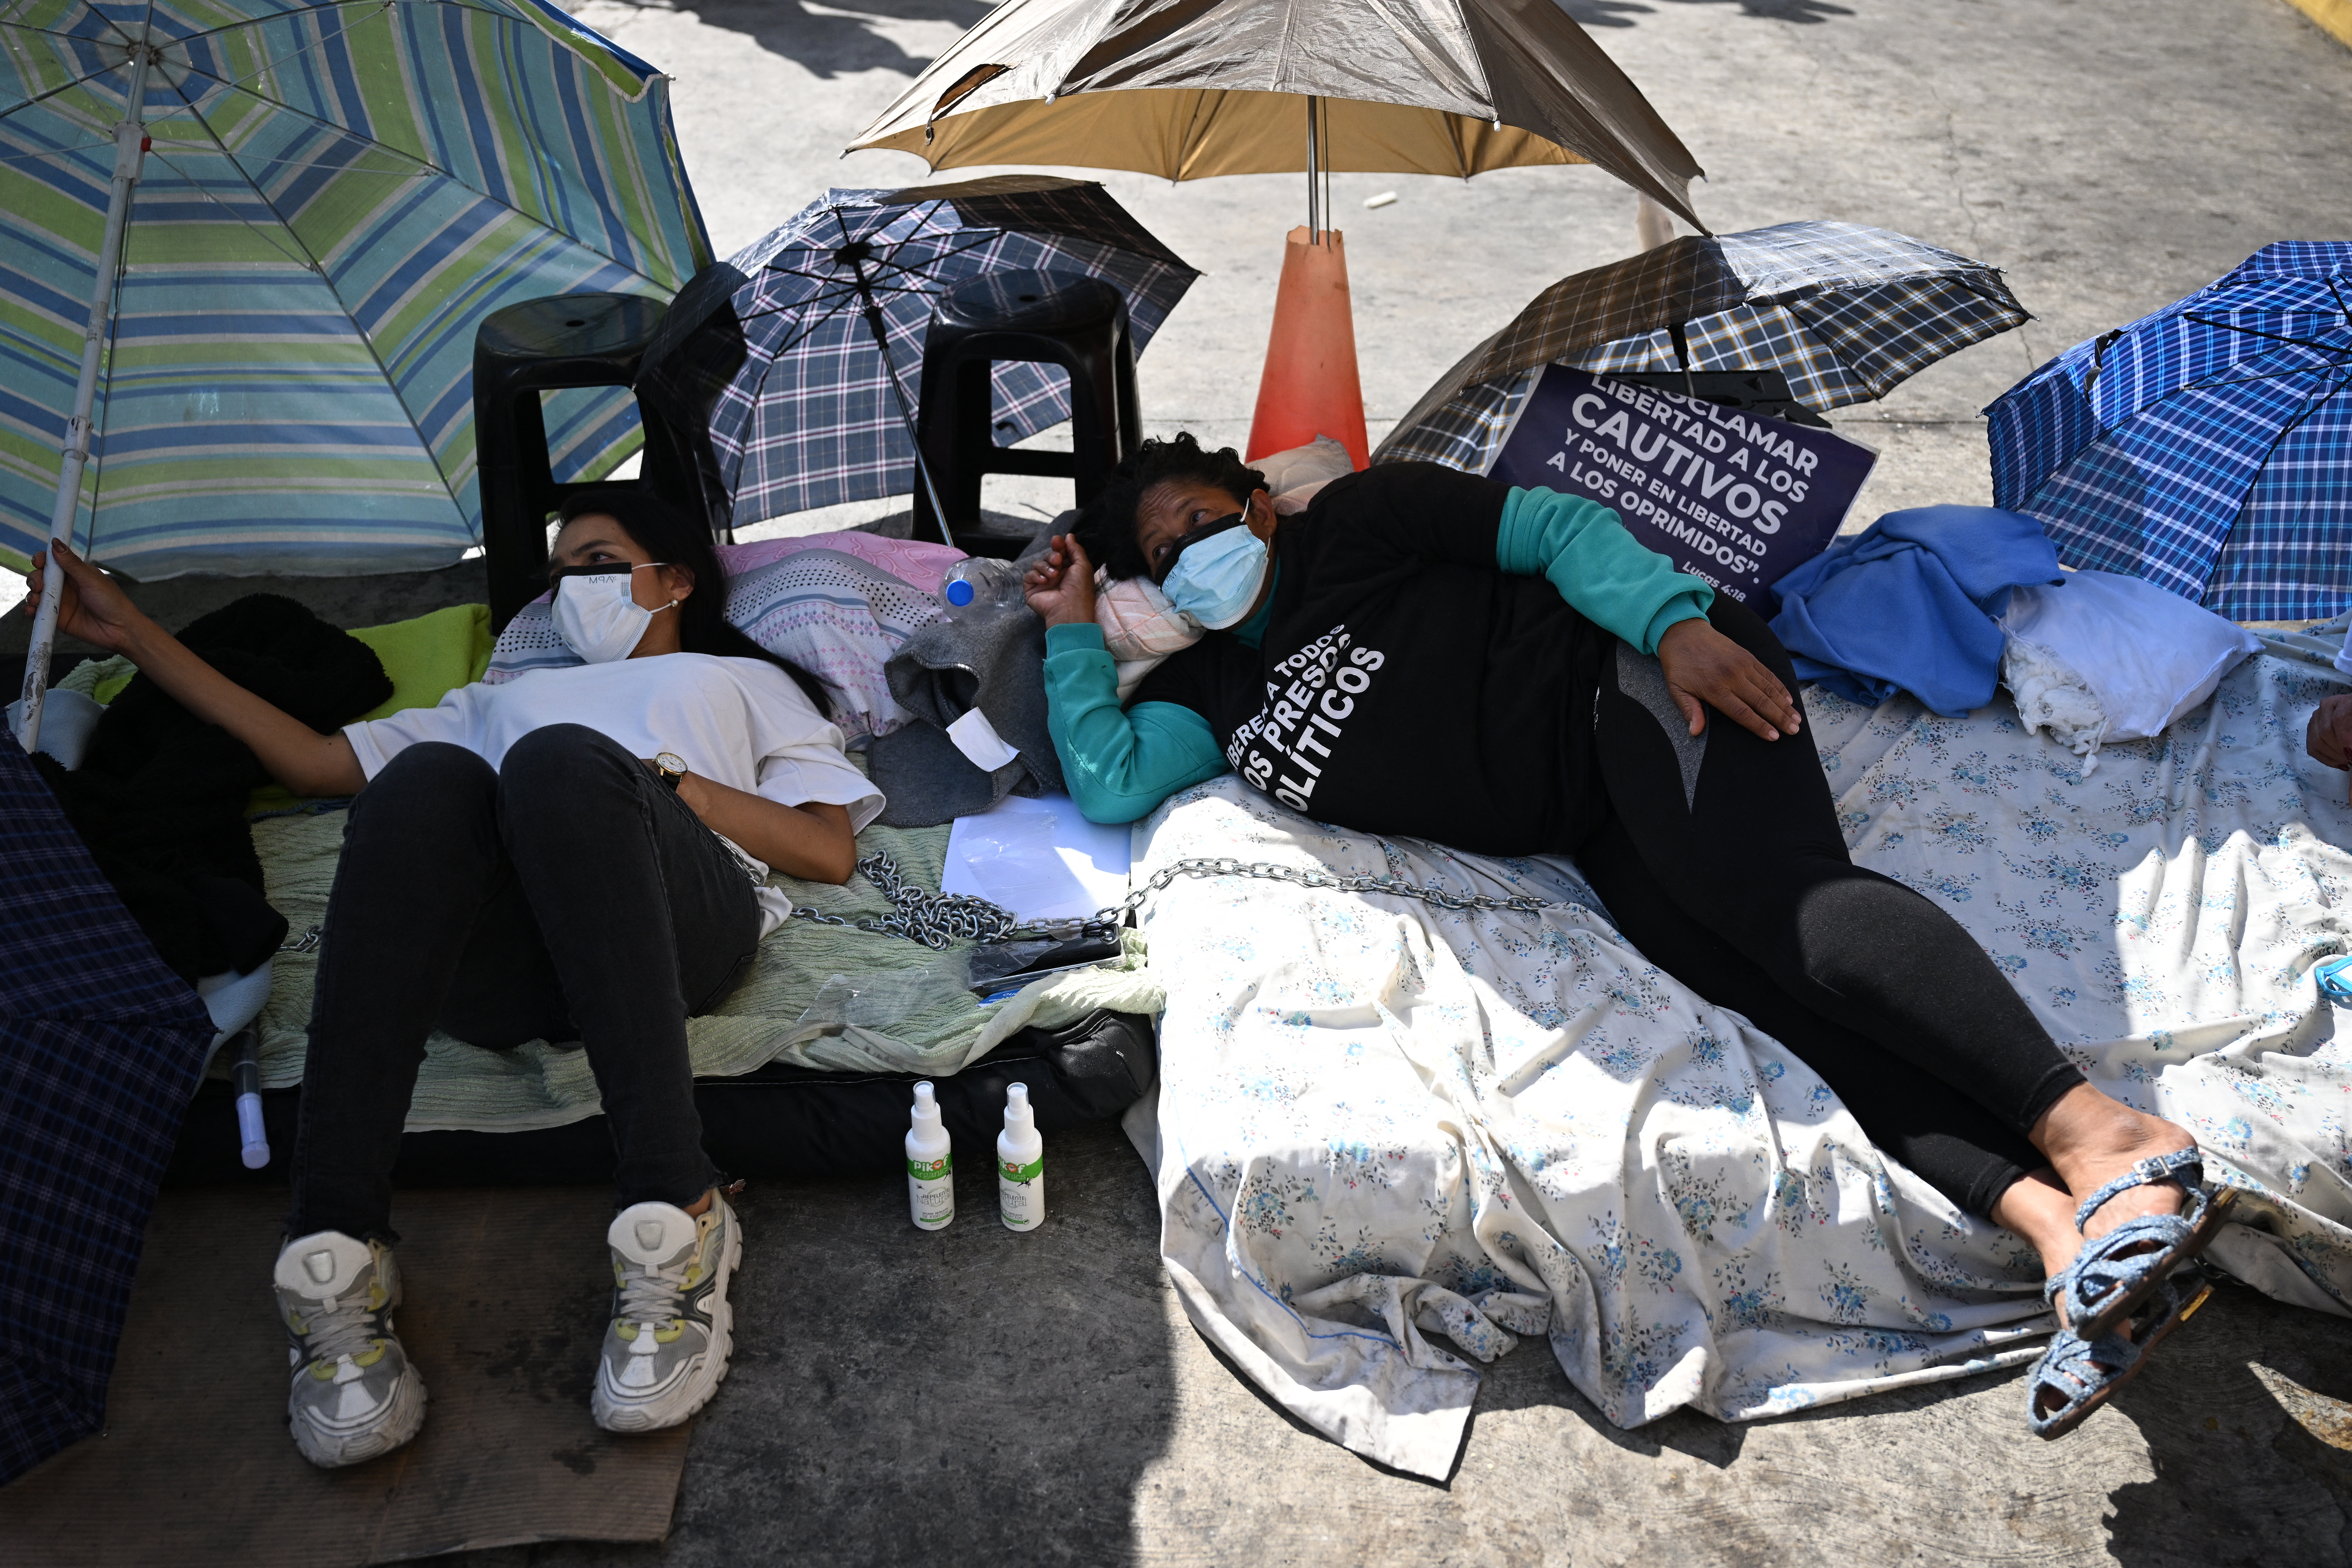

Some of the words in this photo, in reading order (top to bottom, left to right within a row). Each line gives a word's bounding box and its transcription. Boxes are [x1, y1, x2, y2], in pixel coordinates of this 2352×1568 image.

[1546, 451, 1565, 472] A
[1570, 461, 1618, 498] LOS
[1565, 428, 1580, 445] Y
[1579, 438, 1647, 487] PONER
[1648, 478, 1675, 504] EN
[1677, 495, 1767, 556] LIBERTAD
[1572, 393, 1789, 534] CAUTIVOS
[1591, 376, 1726, 453] LIBERTAD
[1727, 447, 1749, 471] A
[1754, 460, 1809, 503] LOS
[1640, 385, 1818, 477] OCLAMAR
[1682, 561, 1720, 588] Lucas
[1721, 584, 1746, 602] 4:18
[1226, 700, 1269, 772] IBEREN
[1267, 681, 1280, 701] A
[1274, 624, 1345, 677] TODOS
[1275, 647, 1385, 811] OLÍTICOS
[1244, 750, 1273, 791] OS
